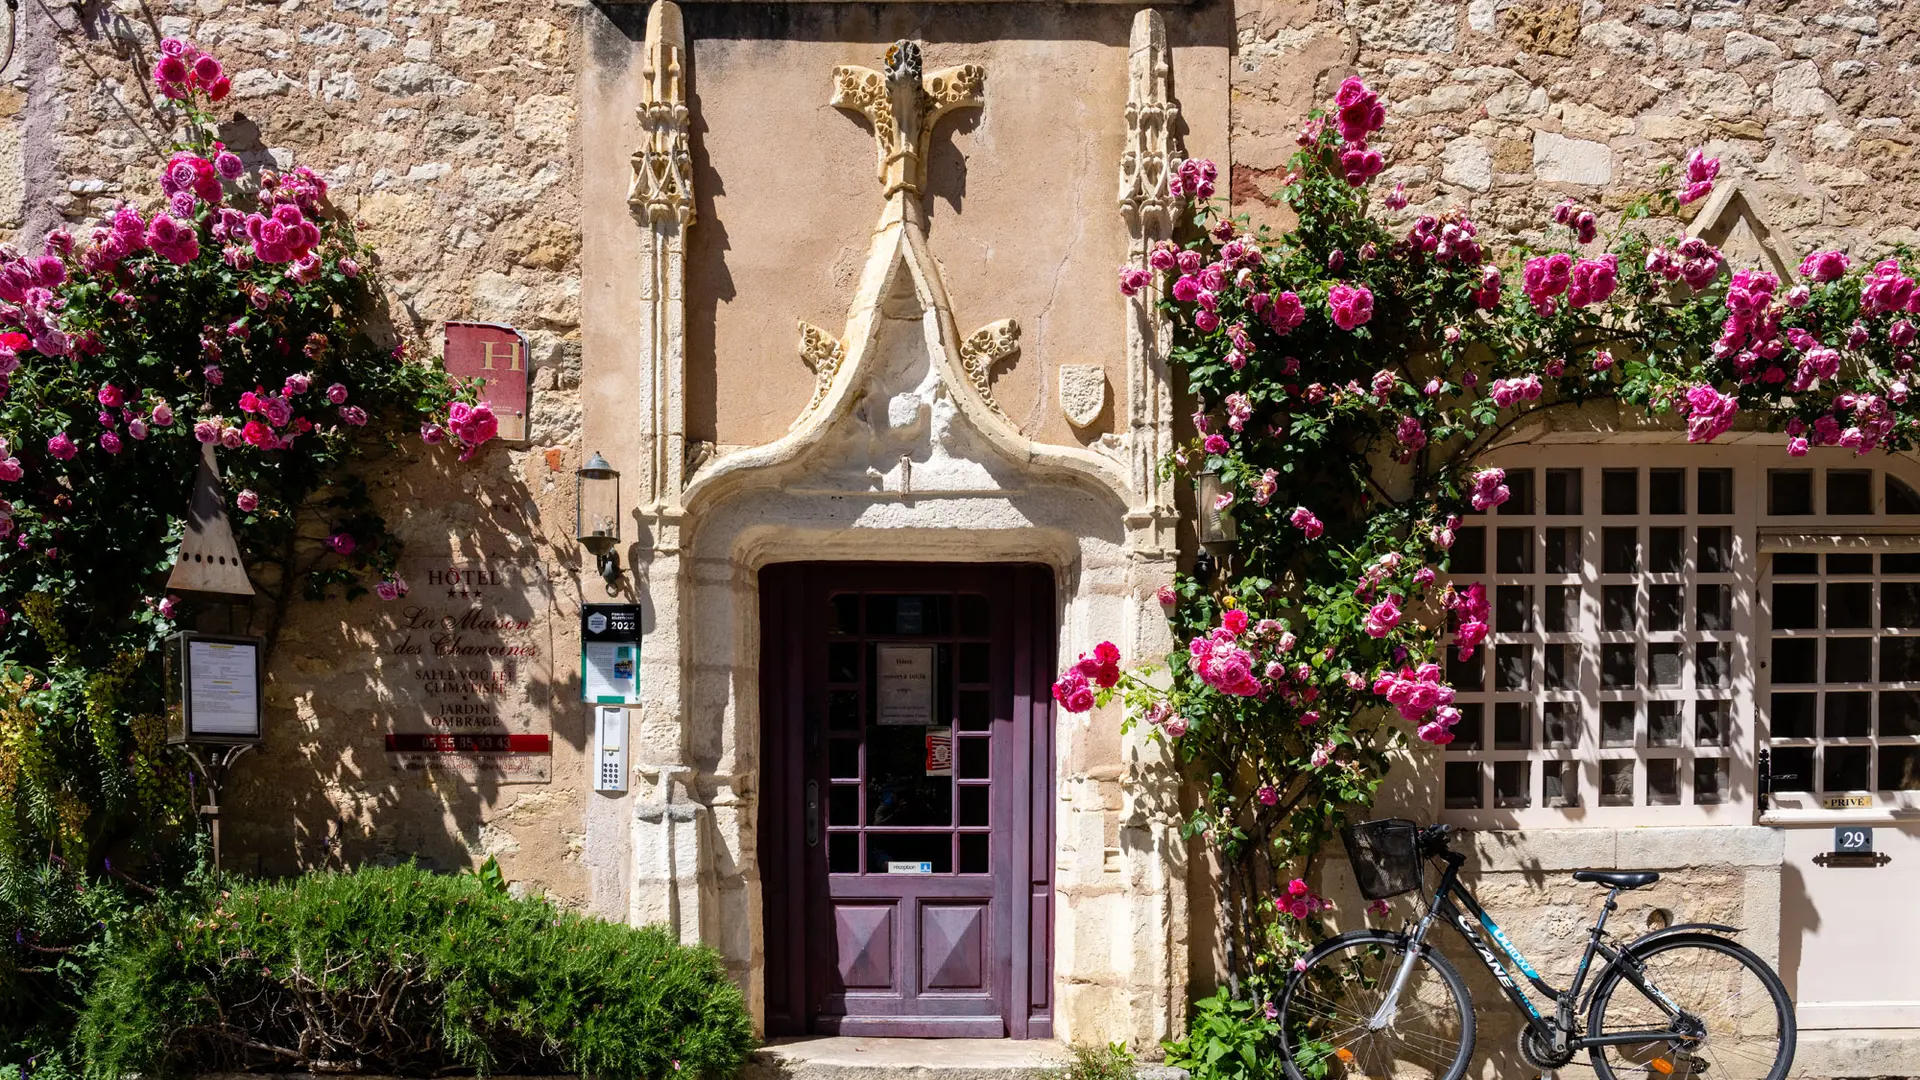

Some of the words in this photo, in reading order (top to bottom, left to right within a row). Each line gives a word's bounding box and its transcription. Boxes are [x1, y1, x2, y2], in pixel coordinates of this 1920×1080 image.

[479, 341, 524, 371] H
[428, 567, 501, 586] HÔTEL
[402, 605, 436, 630] La
[441, 608, 530, 632] Maison
[611, 621, 635, 630] 2022
[393, 636, 422, 655] des
[430, 631, 537, 657] Chanoines
[415, 670, 457, 681] SALLE
[440, 704, 490, 716] JARDIN
[432, 715, 501, 727] OMBRAGÉ
[422, 737, 437, 749] 05
[440, 737, 455, 749] 55
[497, 737, 511, 749] 43
[1831, 797, 1865, 807] PRIVÉ
[1843, 831, 1865, 848] 29
